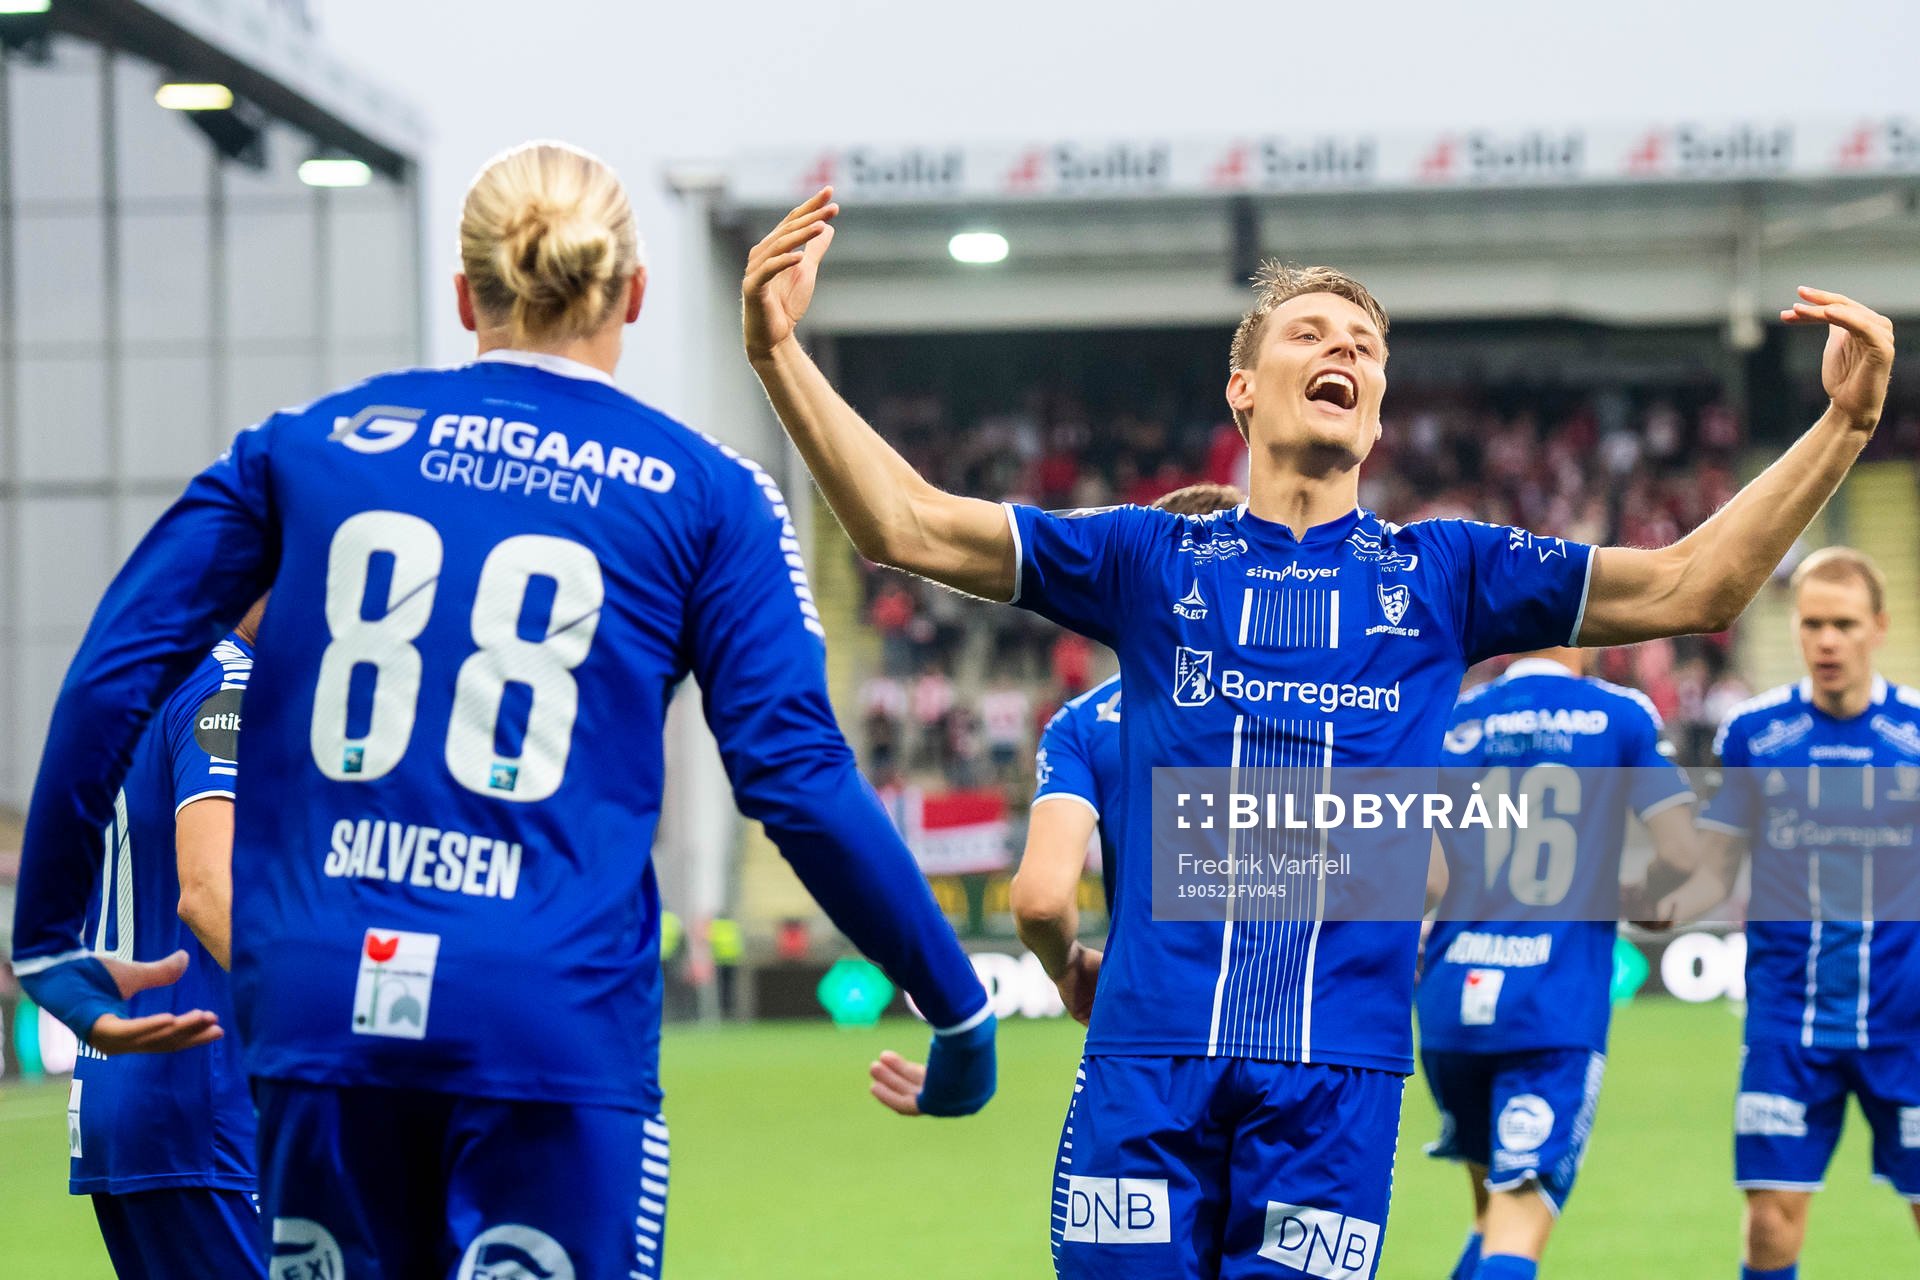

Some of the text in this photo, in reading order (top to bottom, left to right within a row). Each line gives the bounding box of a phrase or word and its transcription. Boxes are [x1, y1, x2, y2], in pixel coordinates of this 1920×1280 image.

[420, 449, 602, 507] GRUPPEN
[429, 414, 676, 493] FRIGAARD
[1246, 561, 1340, 582] simployer
[1173, 603, 1208, 620] SELECT
[310, 510, 605, 802] 88
[1221, 670, 1399, 712] Borregaard
[324, 819, 523, 900] SALVESEN
[1071, 1178, 1155, 1243] DNB
[1278, 1216, 1367, 1272] DNB
